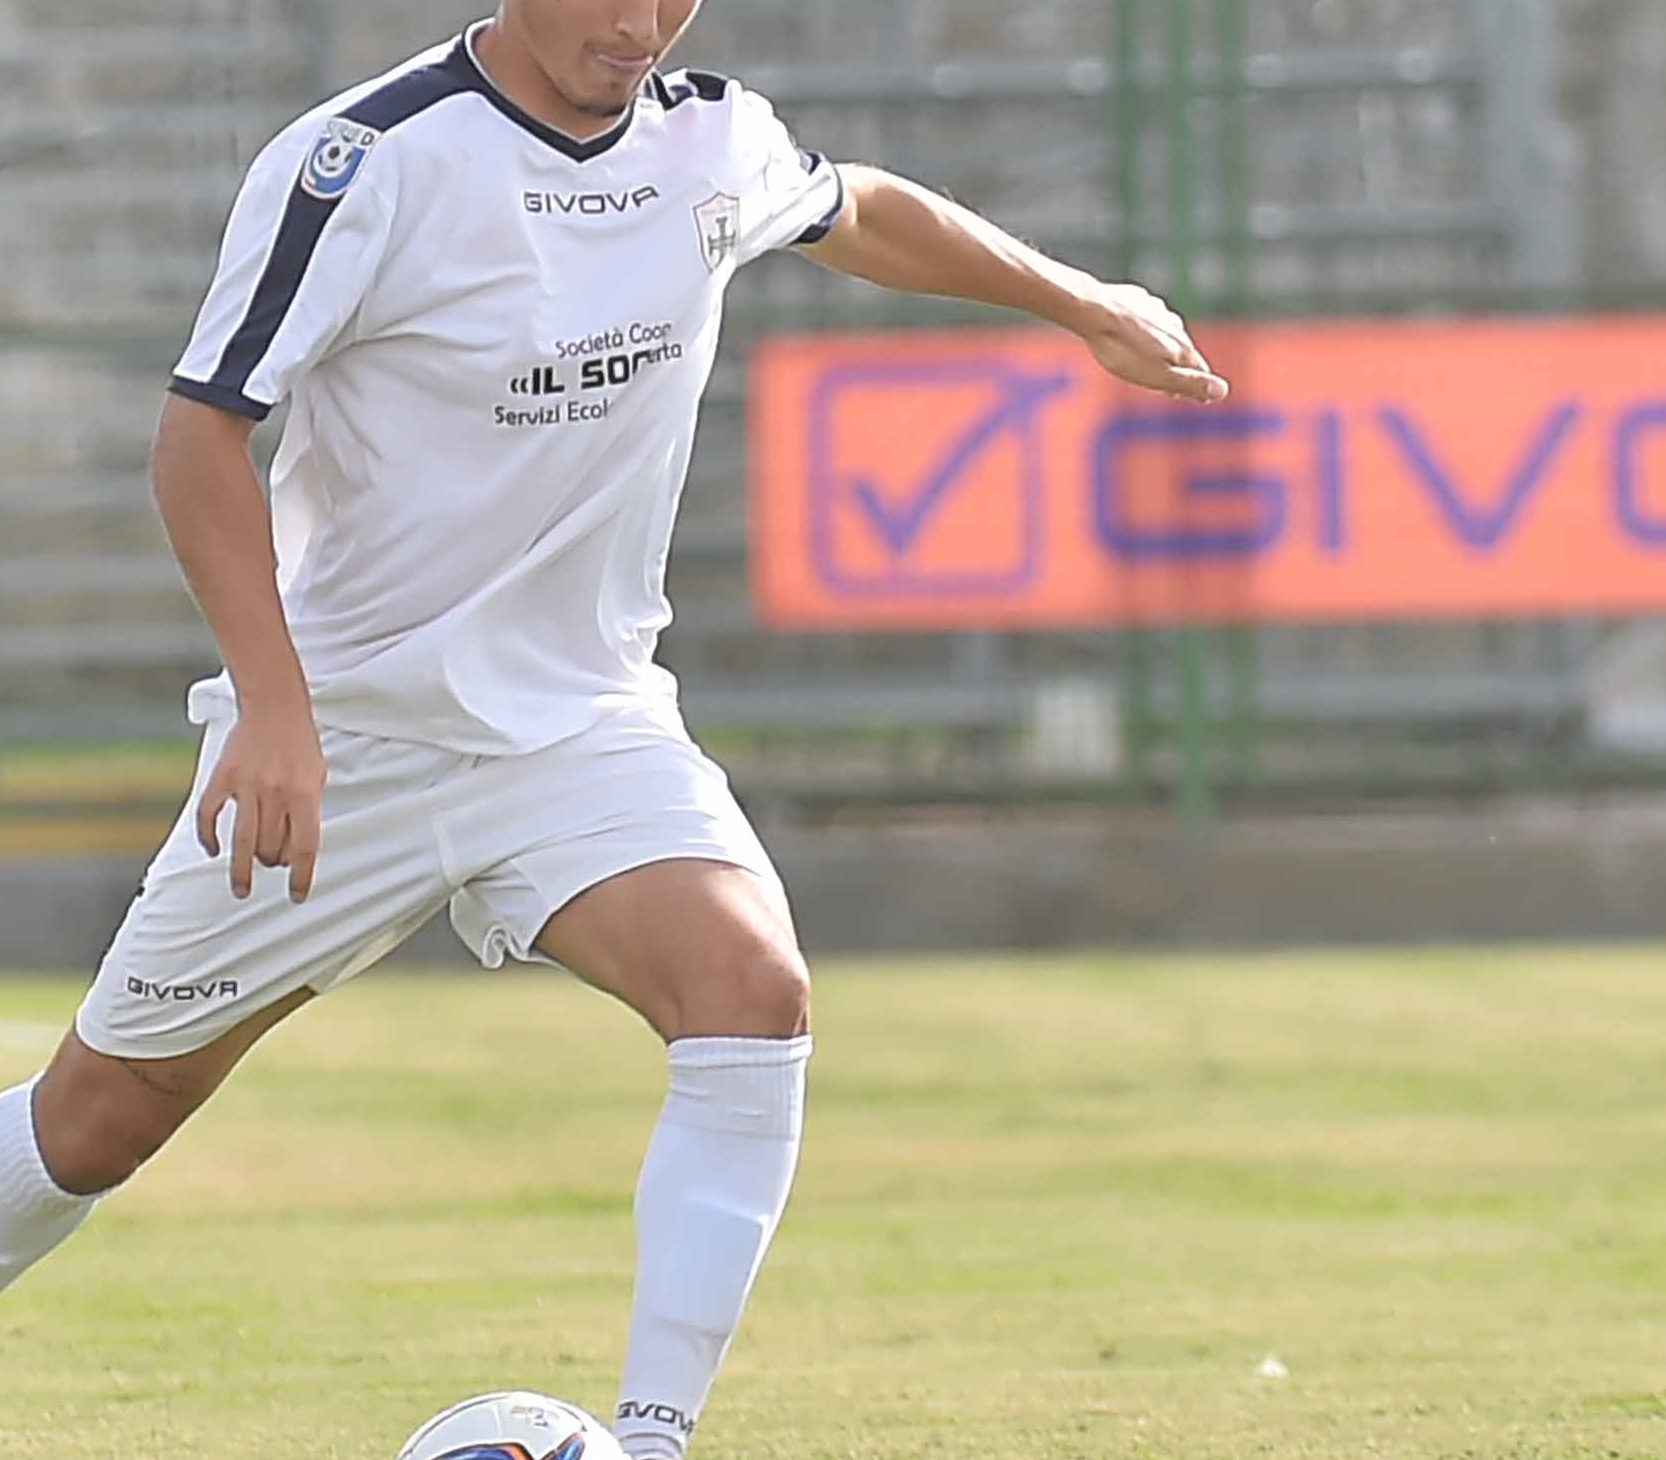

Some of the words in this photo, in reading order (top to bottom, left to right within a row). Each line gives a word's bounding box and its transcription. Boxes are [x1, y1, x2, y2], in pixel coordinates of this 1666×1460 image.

[524, 185, 659, 214] GIVOVA
[555, 328, 624, 358] Società
[494, 405, 561, 426] Servizi
[567, 398, 614, 422] Ecol
[127, 976, 238, 1000] GIVOVA
